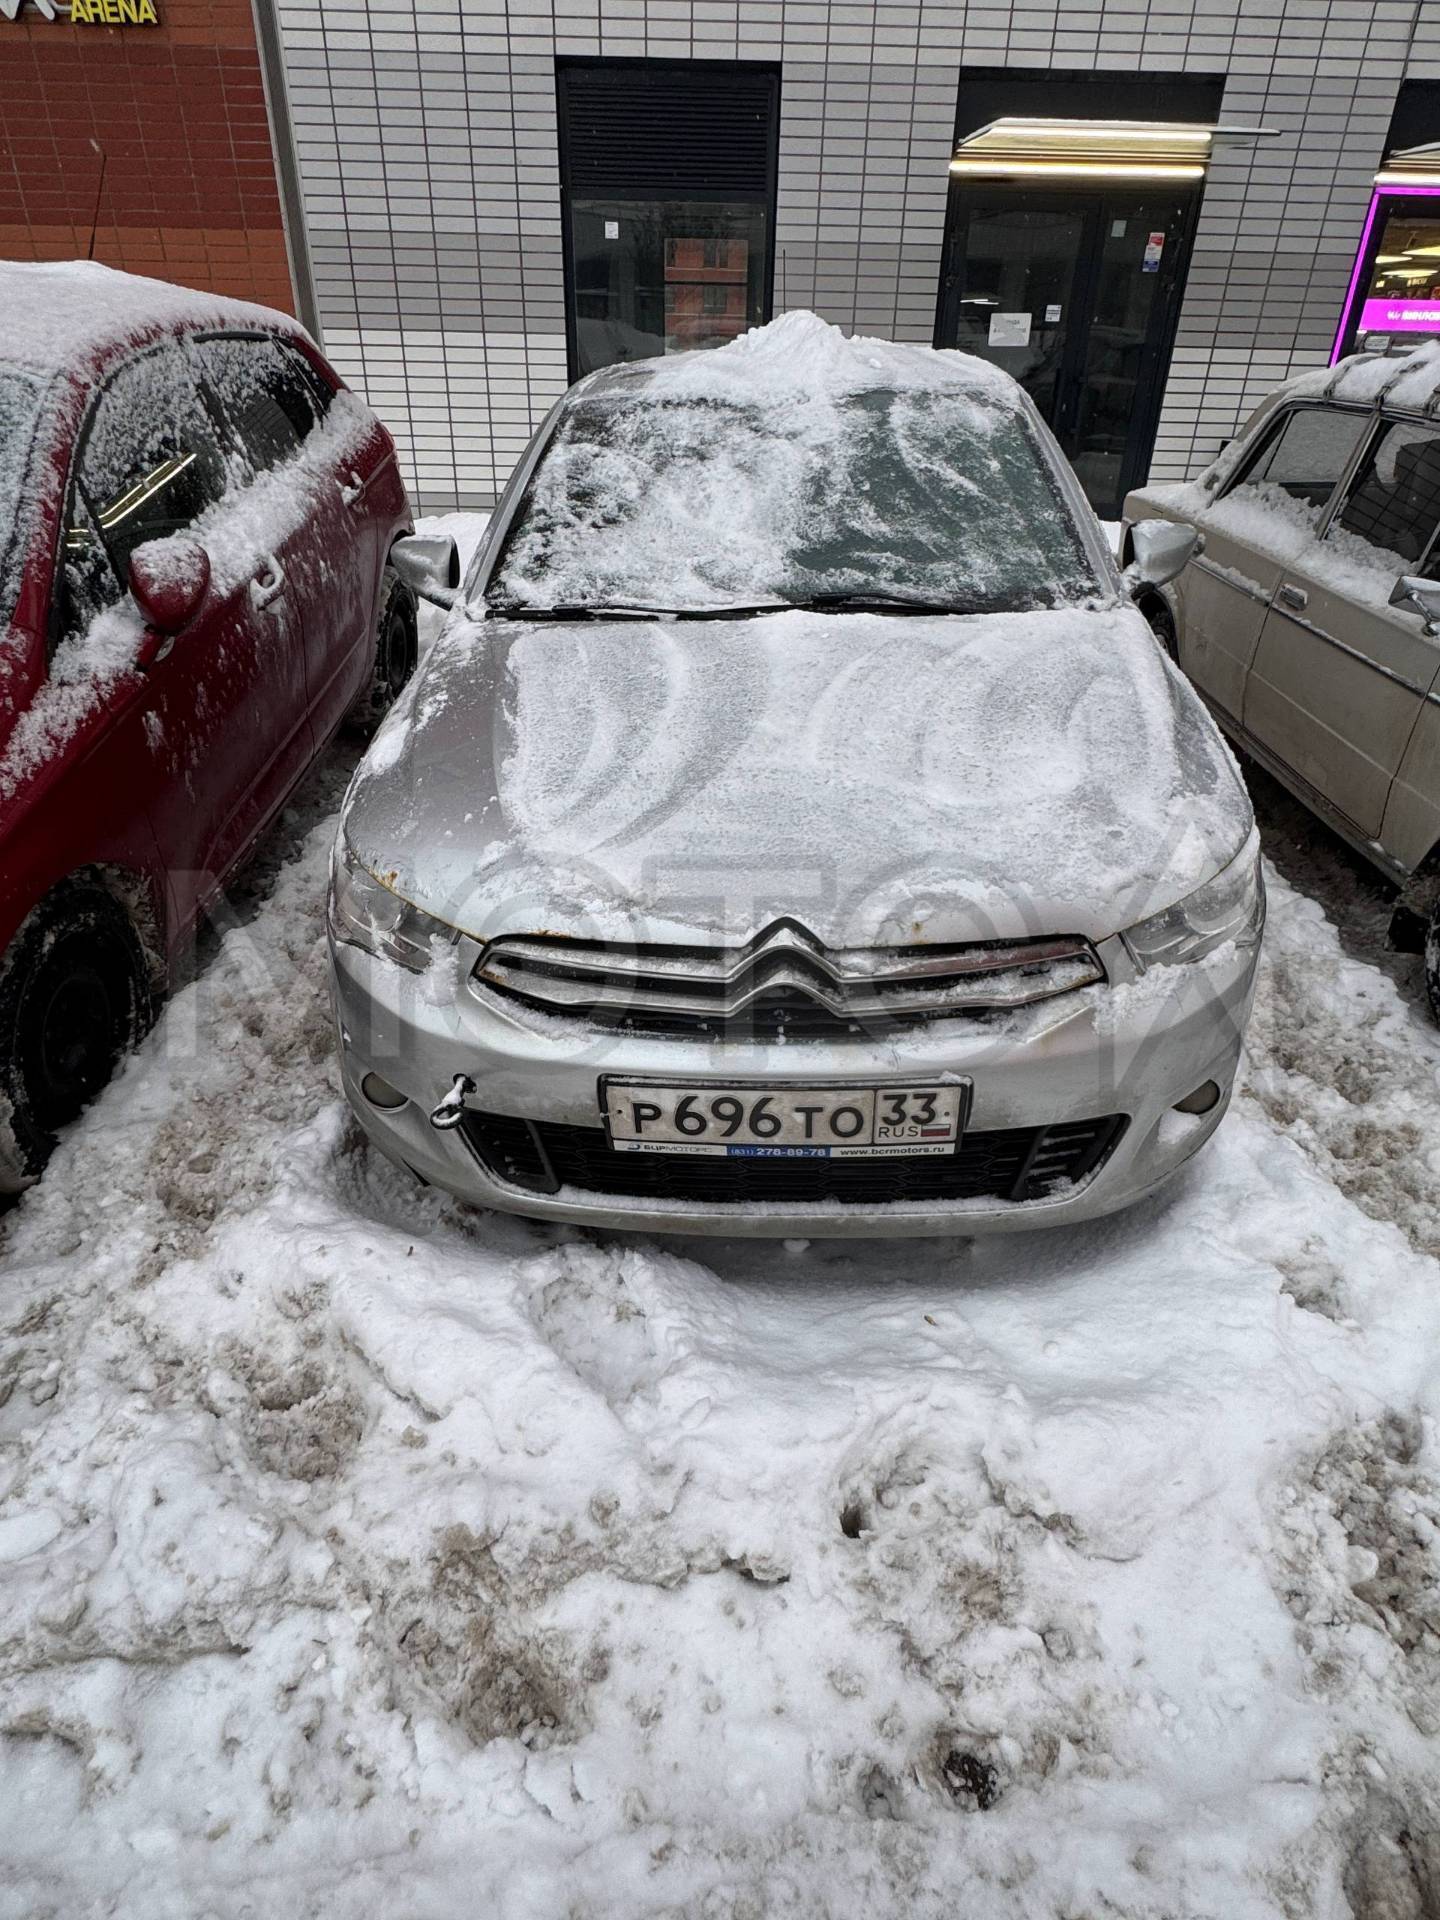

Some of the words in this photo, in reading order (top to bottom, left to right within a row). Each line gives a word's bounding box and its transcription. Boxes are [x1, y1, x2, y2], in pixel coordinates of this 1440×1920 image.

[71, 0, 158, 24] ARENA
[881, 1092, 937, 1126] 33
[877, 1125, 919, 1139] RUS
[839, 1146, 945, 1156] www.bcrmotors.ru
